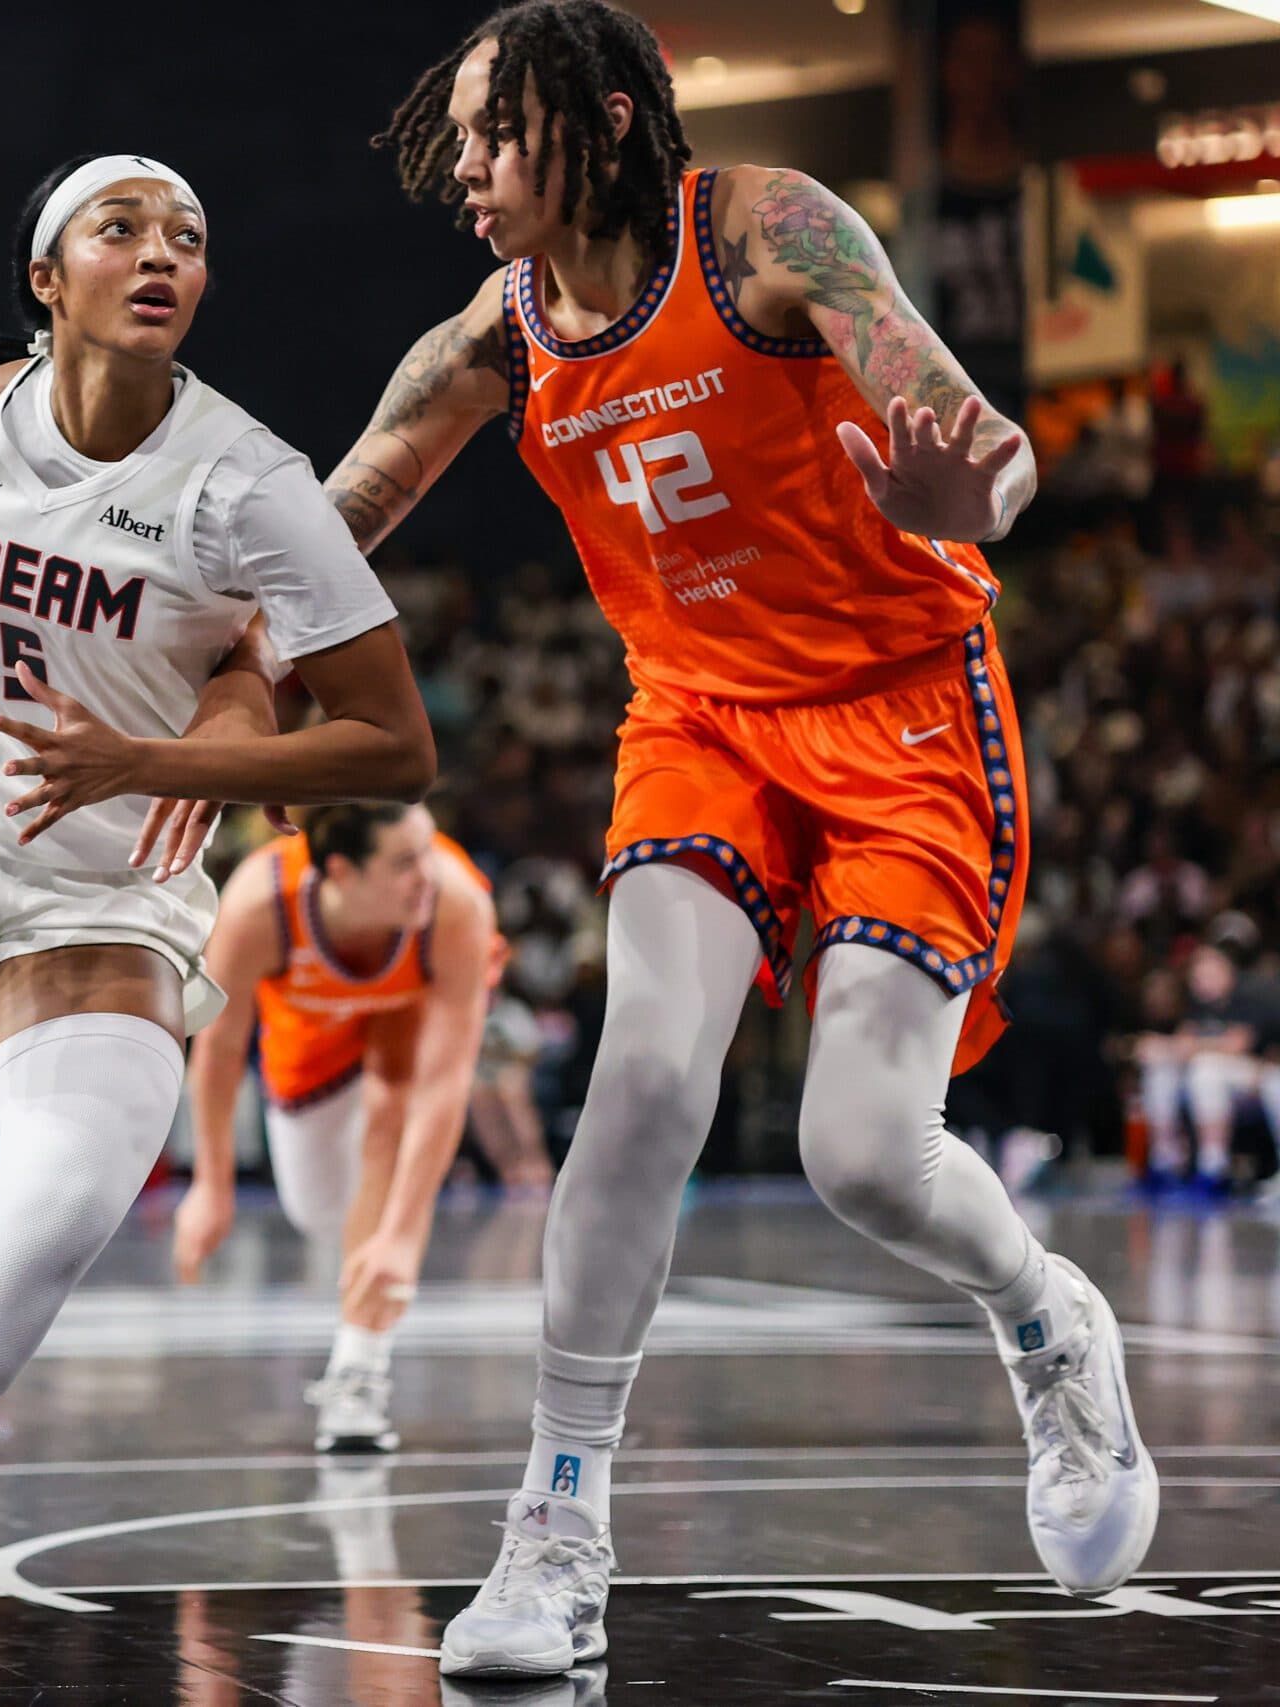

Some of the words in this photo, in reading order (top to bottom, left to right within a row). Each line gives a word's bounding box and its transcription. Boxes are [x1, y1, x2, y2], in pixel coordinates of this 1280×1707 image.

[541, 367, 725, 448] CONNECTICUT
[98, 504, 166, 542] Albert
[593, 430, 731, 535] 42
[0, 621, 50, 702] 5
